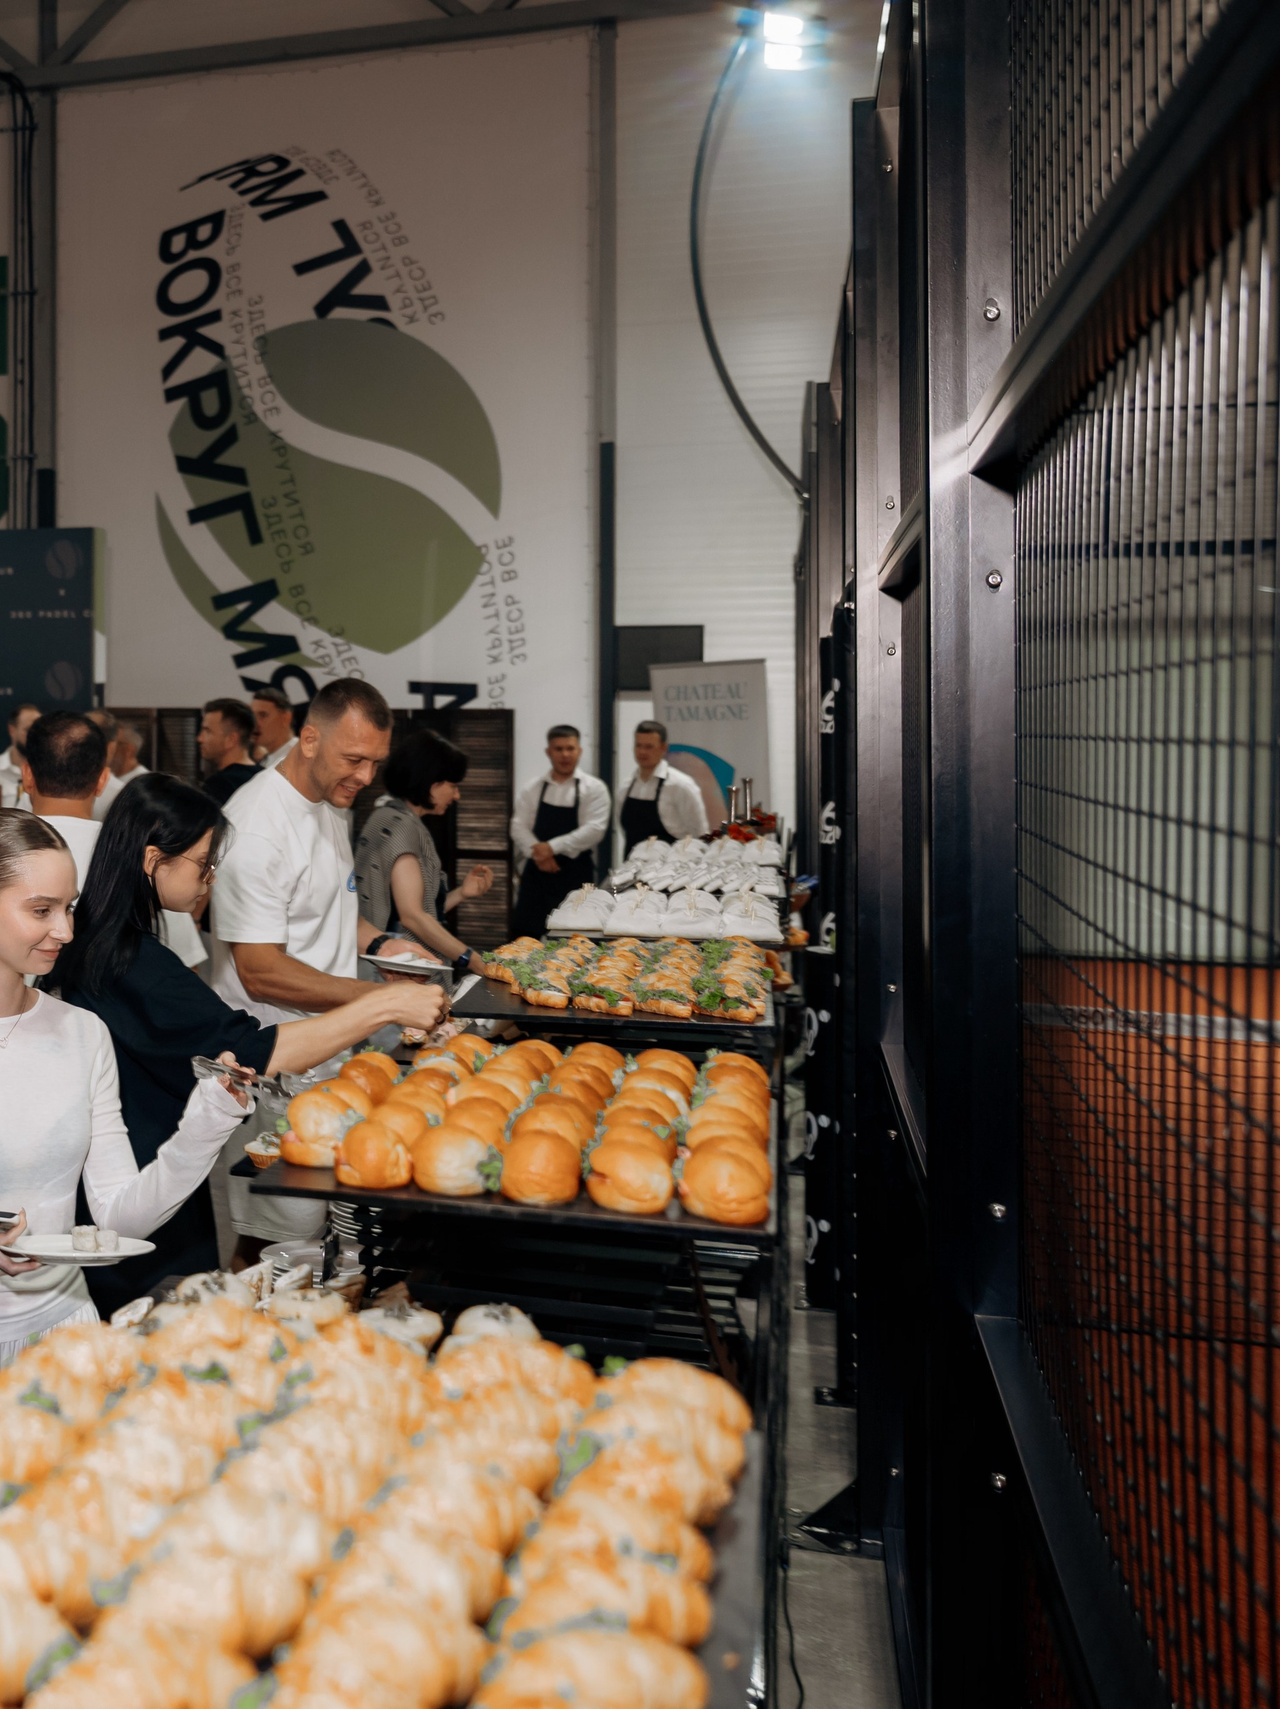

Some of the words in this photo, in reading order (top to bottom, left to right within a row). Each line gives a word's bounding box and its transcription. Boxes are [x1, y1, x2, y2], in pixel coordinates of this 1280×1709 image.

[225, 262, 244, 302] ВСЕ
[156, 209, 264, 547] ВОКРУГ
[256, 375, 281, 419] ВСЕ
[267, 430, 314, 557] КРУТИТСЯ
[261, 495, 295, 575] ЗДЕСЬ
[289, 583, 319, 630] ВСЕ
[329, 626, 366, 680] ЗДЕС
[663, 681, 748, 703] CHATEAU
[664, 703, 750, 723] TAMAGNE
